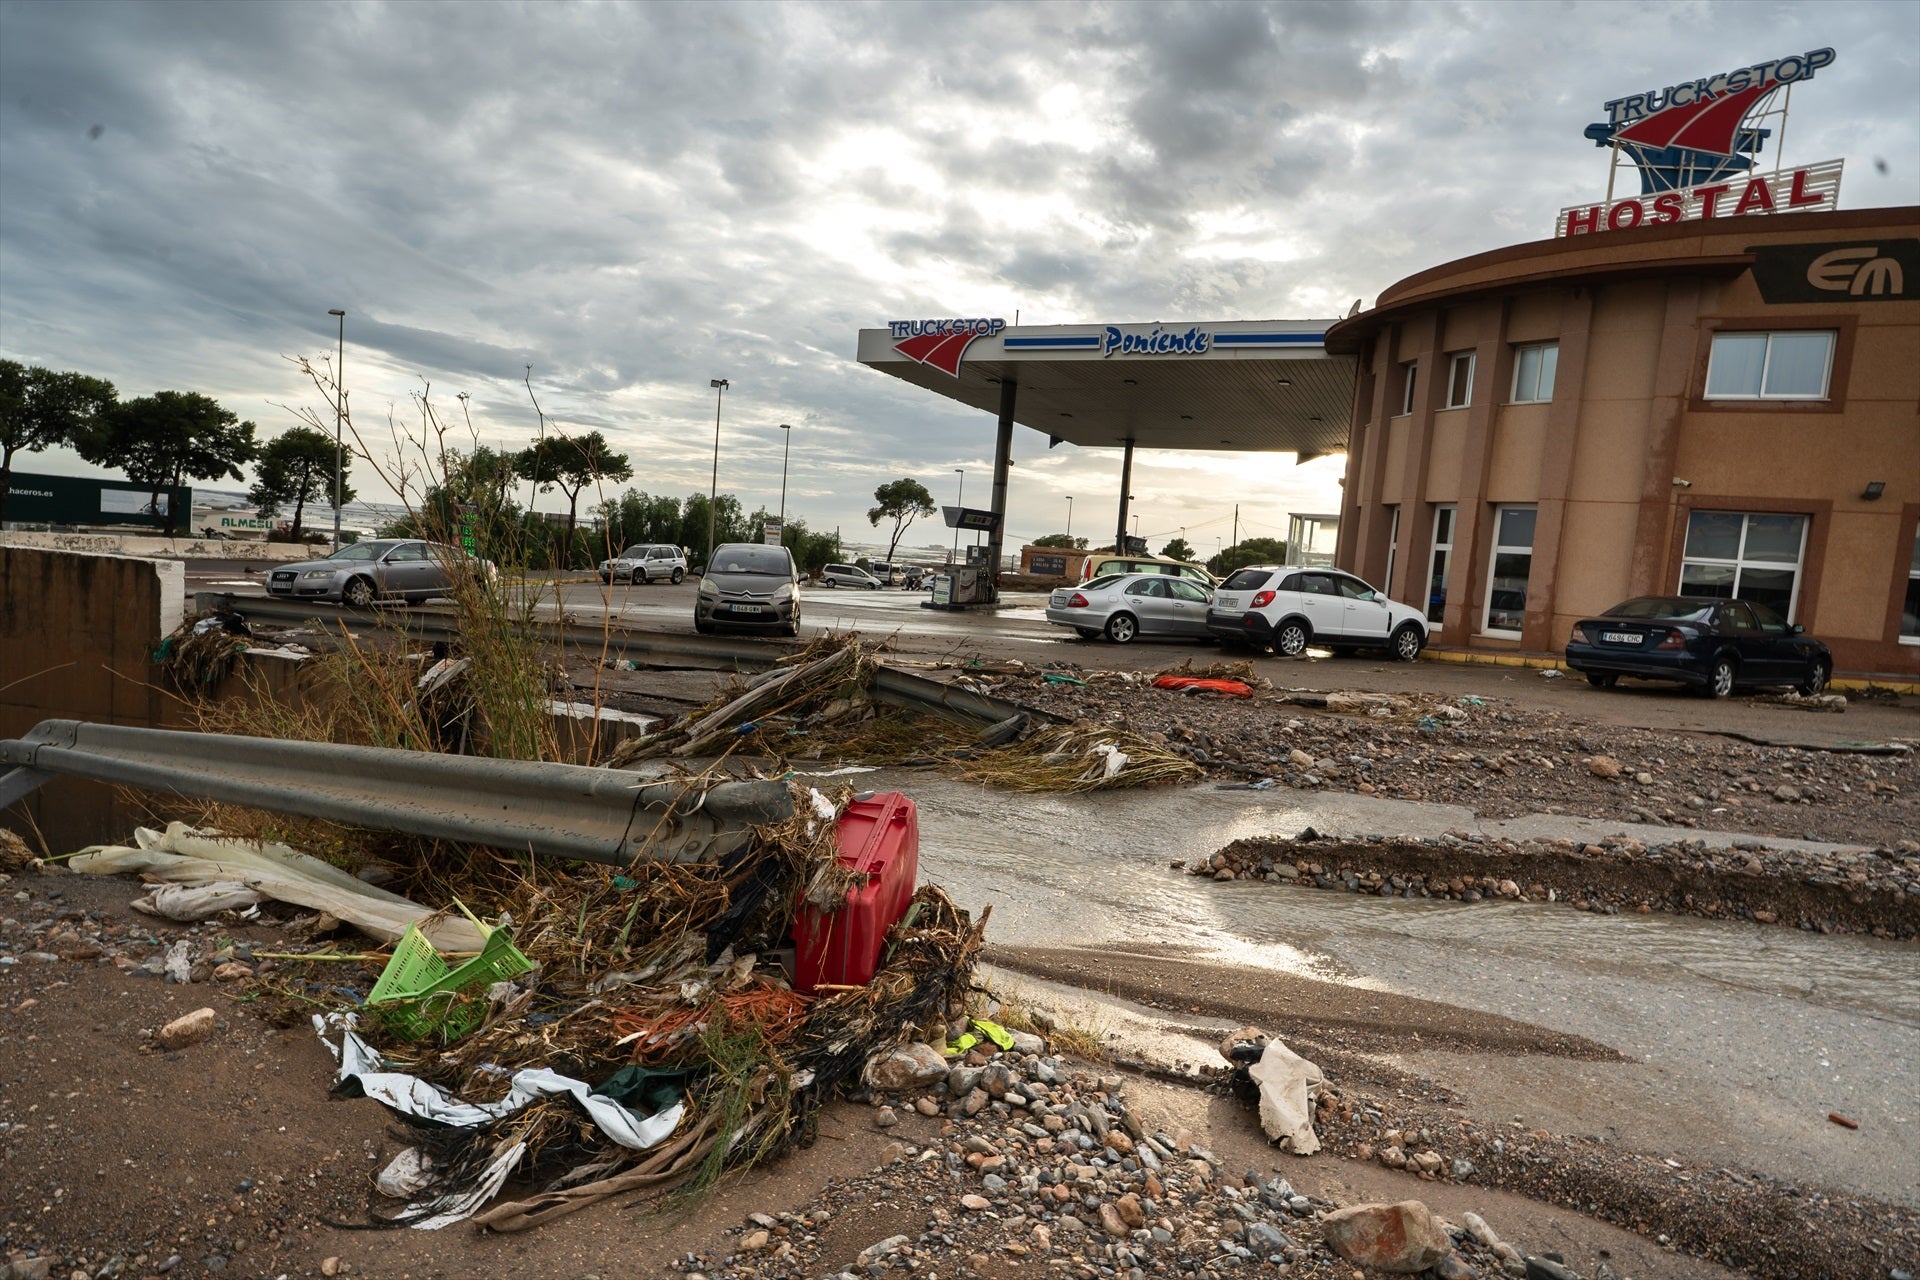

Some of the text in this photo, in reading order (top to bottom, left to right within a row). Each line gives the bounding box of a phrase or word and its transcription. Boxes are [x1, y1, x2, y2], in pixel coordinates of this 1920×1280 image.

[1606, 49, 1835, 121] TRUCK STOP
[1567, 169, 1824, 236] HOSTAL
[889, 318, 1005, 337] TRUCK STOP
[1105, 326, 1206, 355] Poniente
